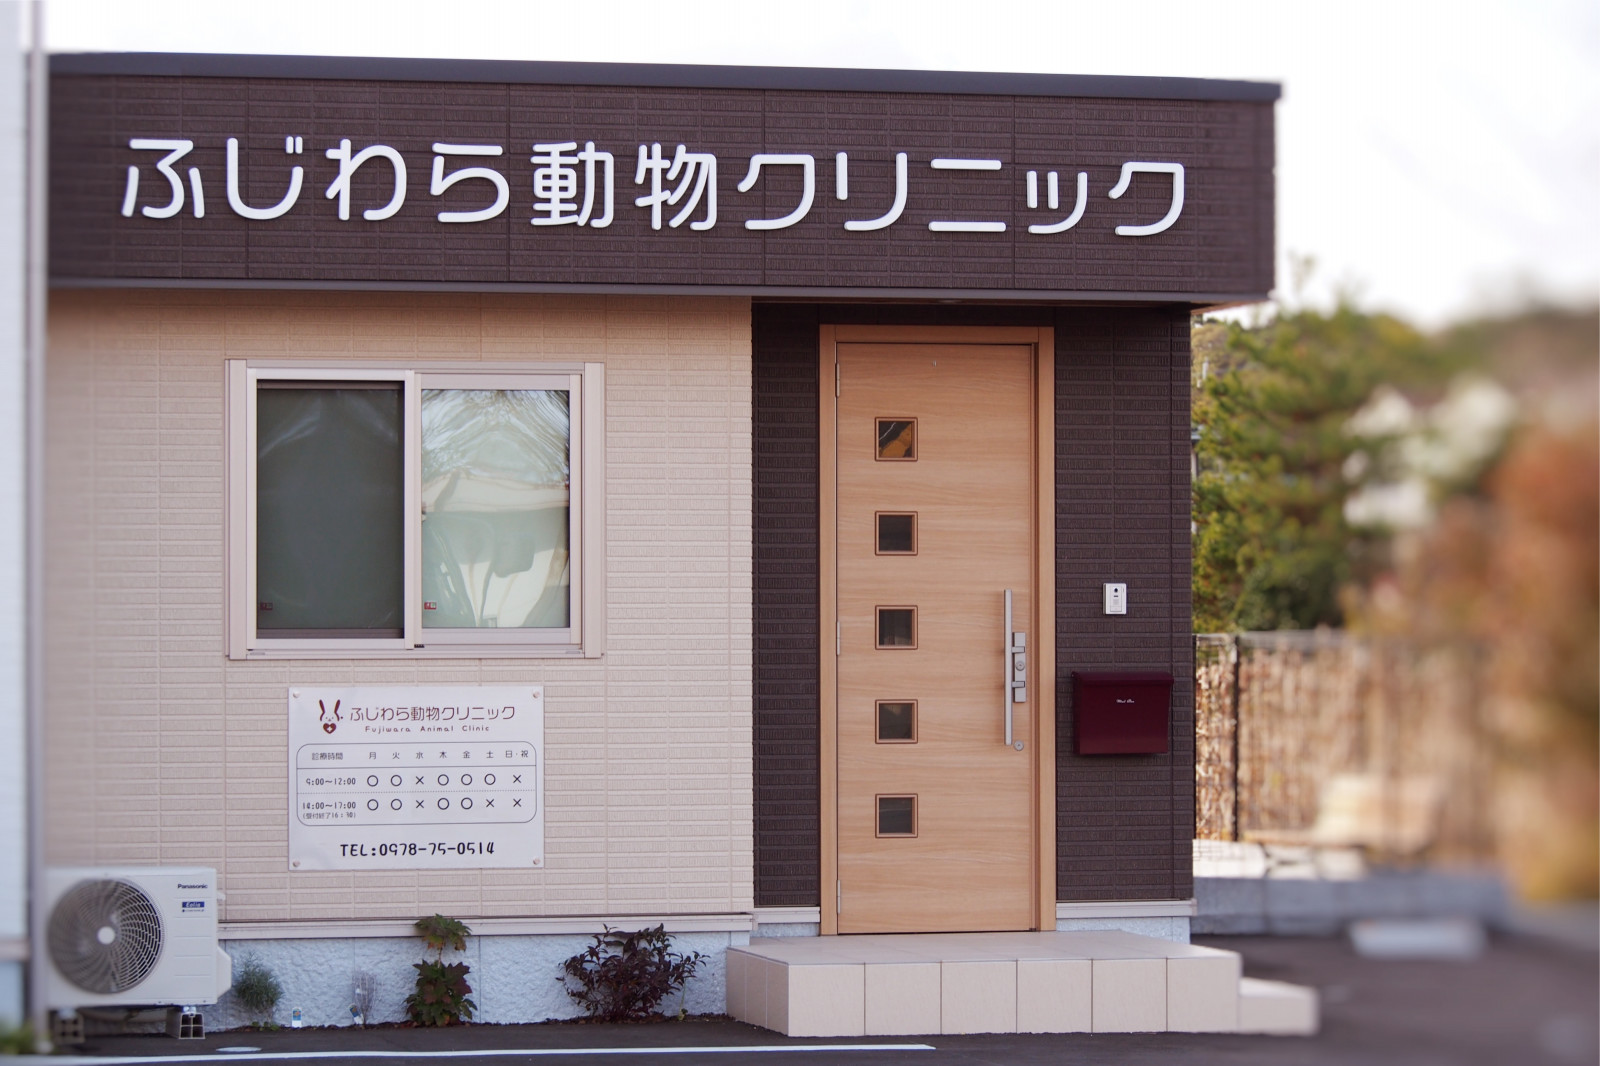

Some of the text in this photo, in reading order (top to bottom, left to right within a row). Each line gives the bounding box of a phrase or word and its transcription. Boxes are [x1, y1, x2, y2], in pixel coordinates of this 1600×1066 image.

[121, 135, 1187, 238] ふじわら動物クリニック
[349, 705, 516, 722] ふじわら動物クリニック
[364, 724, 490, 734] Fujiwara Animal Clinic
[368, 751, 377, 760] 月
[392, 751, 400, 760] 火
[415, 751, 424, 760] 水
[439, 751, 447, 759] 木
[462, 750, 471, 759] 金
[485, 751, 494, 759] 土
[339, 841, 495, 857] TEL:0978-75-0514
